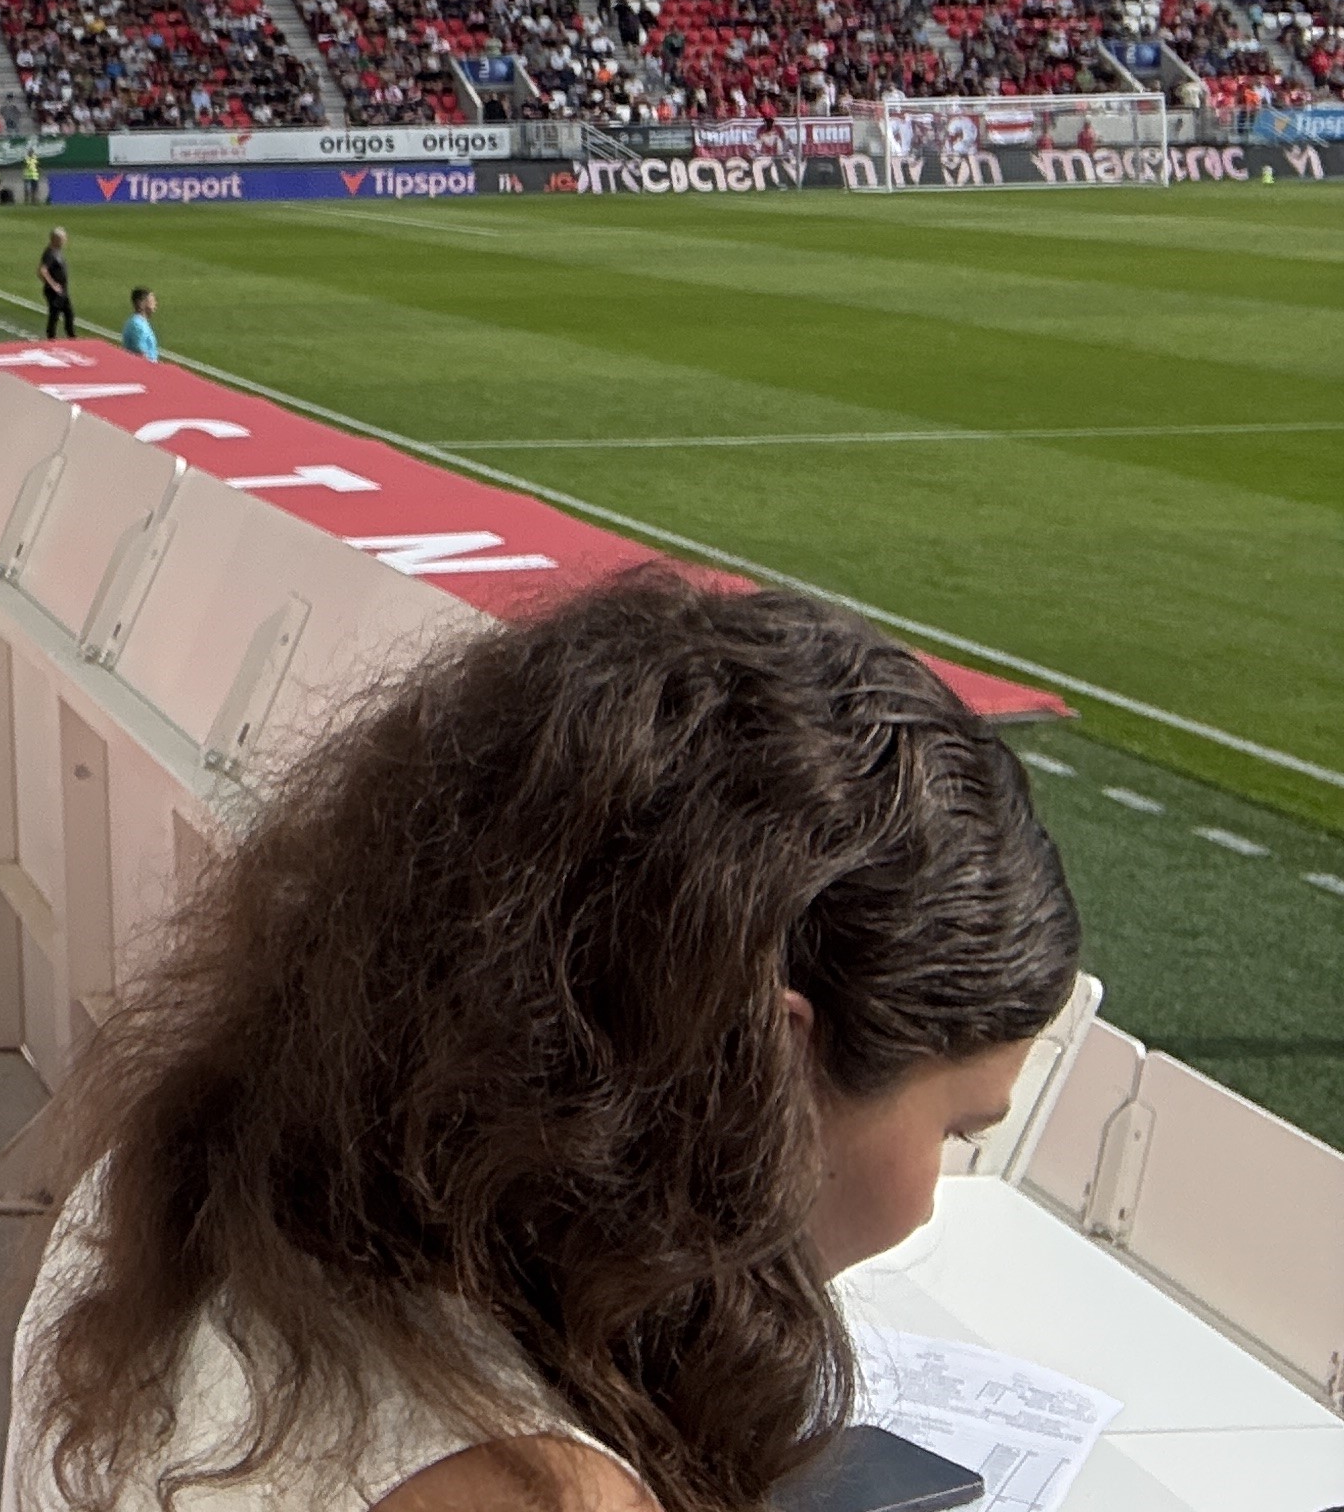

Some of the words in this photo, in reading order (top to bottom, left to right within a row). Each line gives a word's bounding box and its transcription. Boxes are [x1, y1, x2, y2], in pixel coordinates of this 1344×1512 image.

[320, 127, 395, 157] origos
[423, 126, 499, 157] origos
[127, 171, 242, 204] Tipsport
